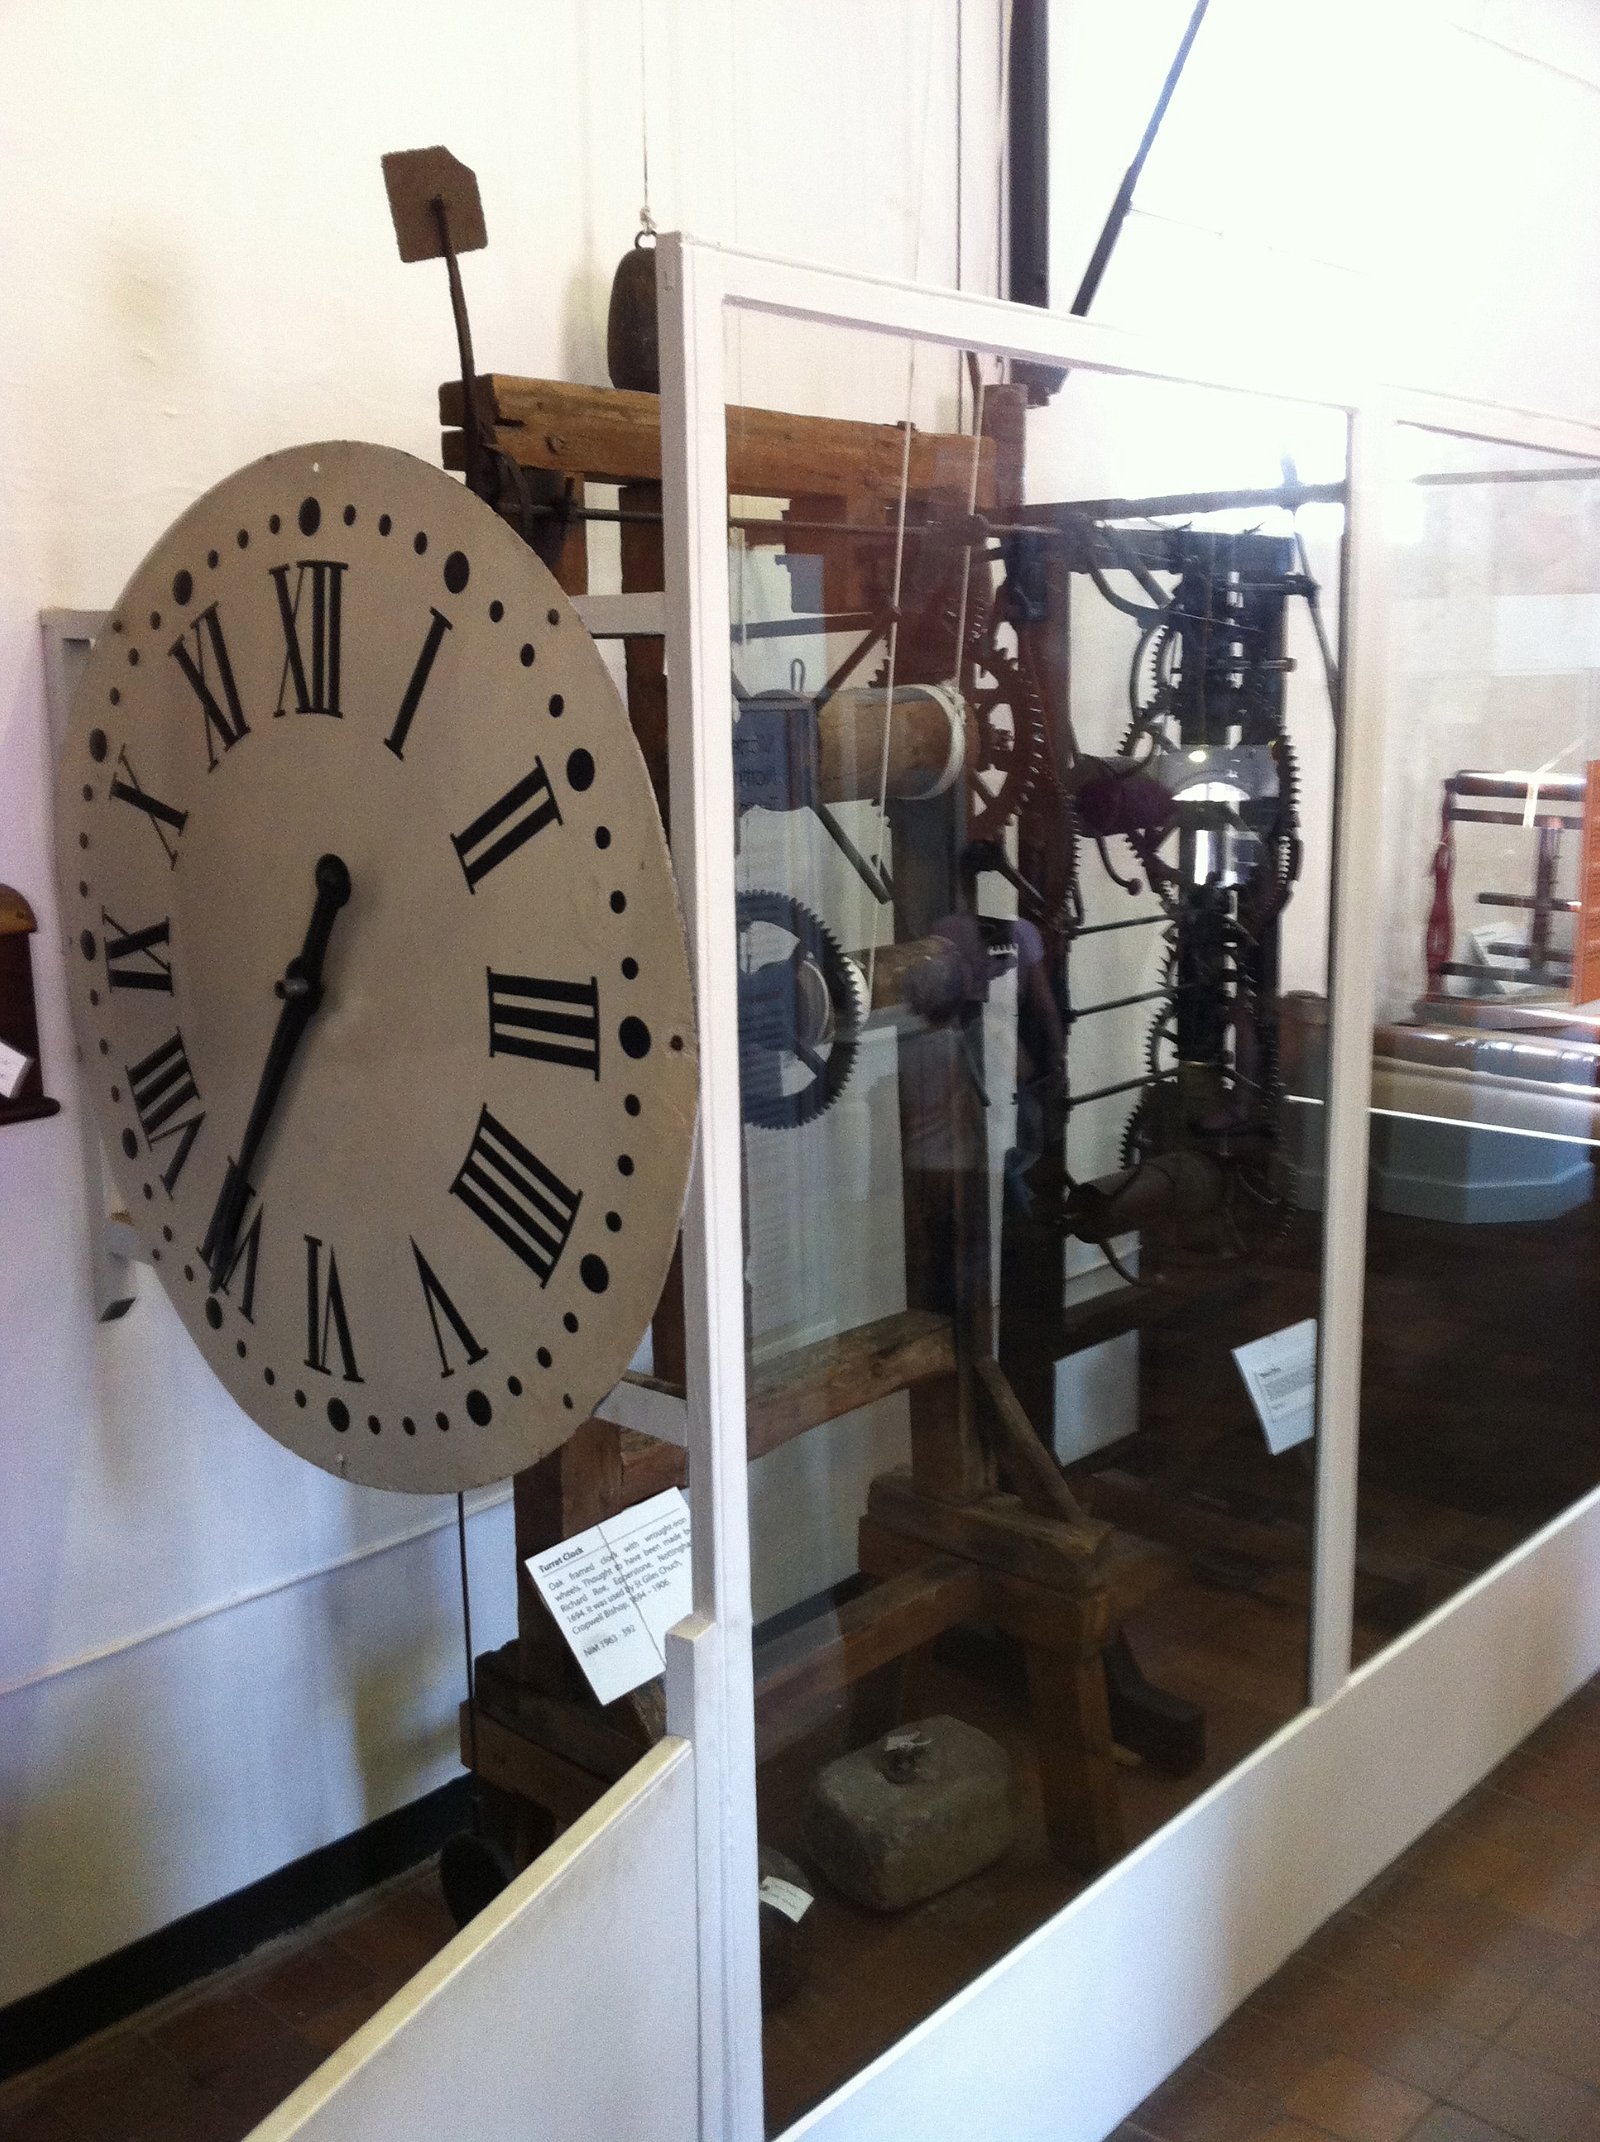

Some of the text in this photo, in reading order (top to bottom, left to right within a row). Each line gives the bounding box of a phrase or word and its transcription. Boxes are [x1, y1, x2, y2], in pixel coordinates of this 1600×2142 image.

[168, 601, 251, 774] XI
[269, 559, 348, 719] XII
[383, 606, 453, 761] I
[110, 744, 189, 870] X
[450, 755, 563, 895] II
[101, 905, 175, 997] IX
[486, 966, 600, 1082] III
[125, 1026, 206, 1200] VIII
[448, 1102, 583, 1290] IIII
[304, 1234, 365, 1383] VI
[409, 1234, 489, 1378] V
[538, 1546, 584, 1574] Turret Clock
[548, 1578, 565, 1592] Oak
[568, 1562, 596, 1581] framed
[600, 1551, 619, 1565] clock
[623, 1540, 640, 1553] with
[559, 1593, 589, 1613] Richard
[581, 1567, 614, 1588] Thought
[613, 1563, 624, 1572] to
[623, 1553, 642, 1566] have
[642, 1543, 662, 1557] been
[662, 1532, 682, 1547] made
[592, 1598, 608, 1610] was
[607, 1588, 626, 1603] used
[624, 1583, 635, 1594] by
[633, 1579, 644, 1589] St
[641, 1571, 660, 1584] Giles
[571, 1613, 605, 1635] Cropwell
